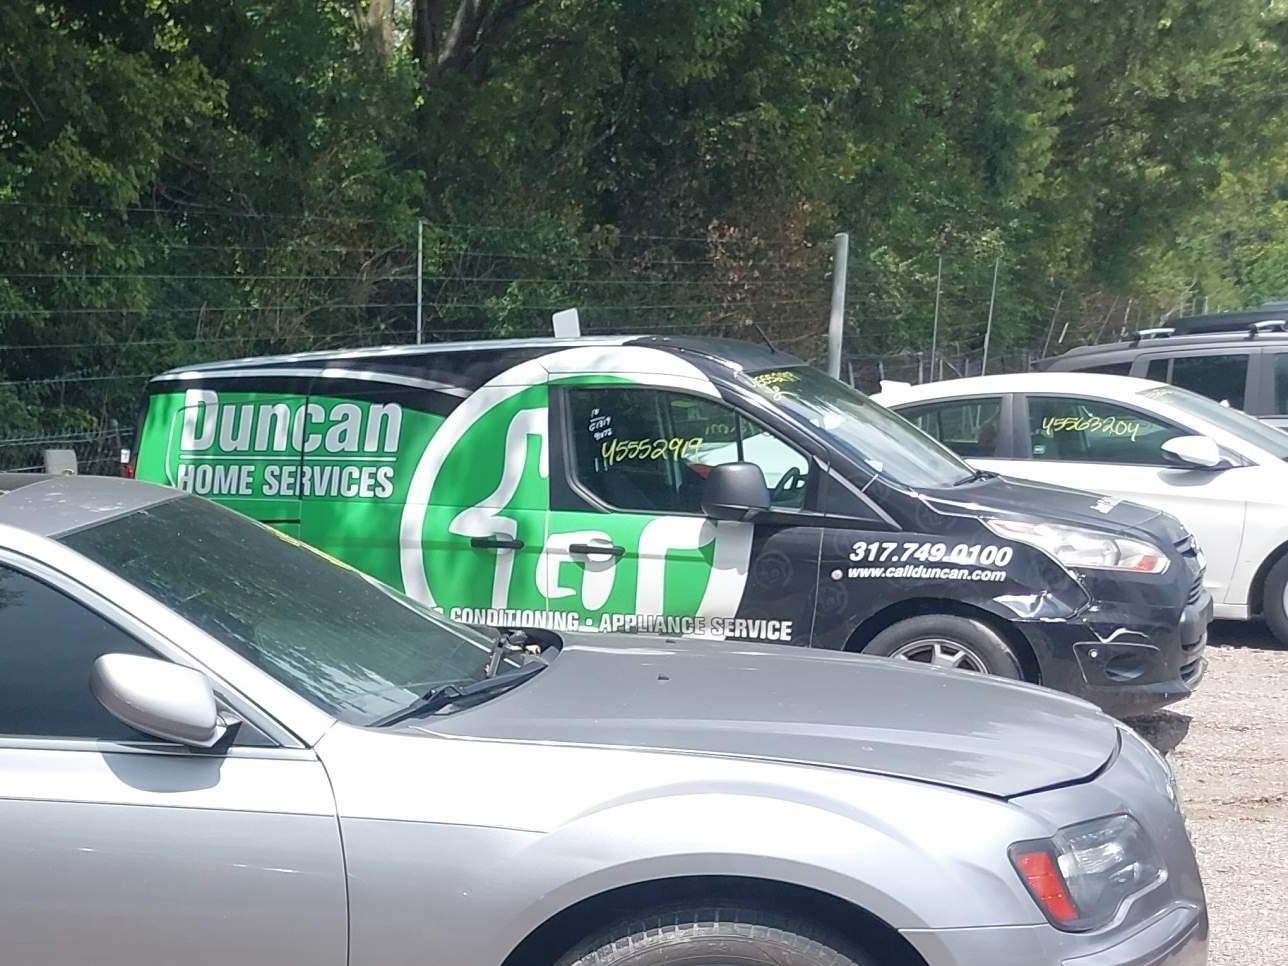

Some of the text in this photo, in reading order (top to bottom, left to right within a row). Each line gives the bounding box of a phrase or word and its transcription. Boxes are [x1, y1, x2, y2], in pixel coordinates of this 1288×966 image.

[180, 389, 402, 453] Duncan
[1042, 416, 1140, 442] 45563204
[177, 464, 395, 499] HOME SERVICES
[849, 541, 1013, 567] 317.749.0100
[847, 564, 1006, 582] www.callduncan.com
[449, 607, 580, 632] CONDITIONING
[598, 613, 706, 636] APPLIANCE
[711, 618, 793, 641] SERVICE
